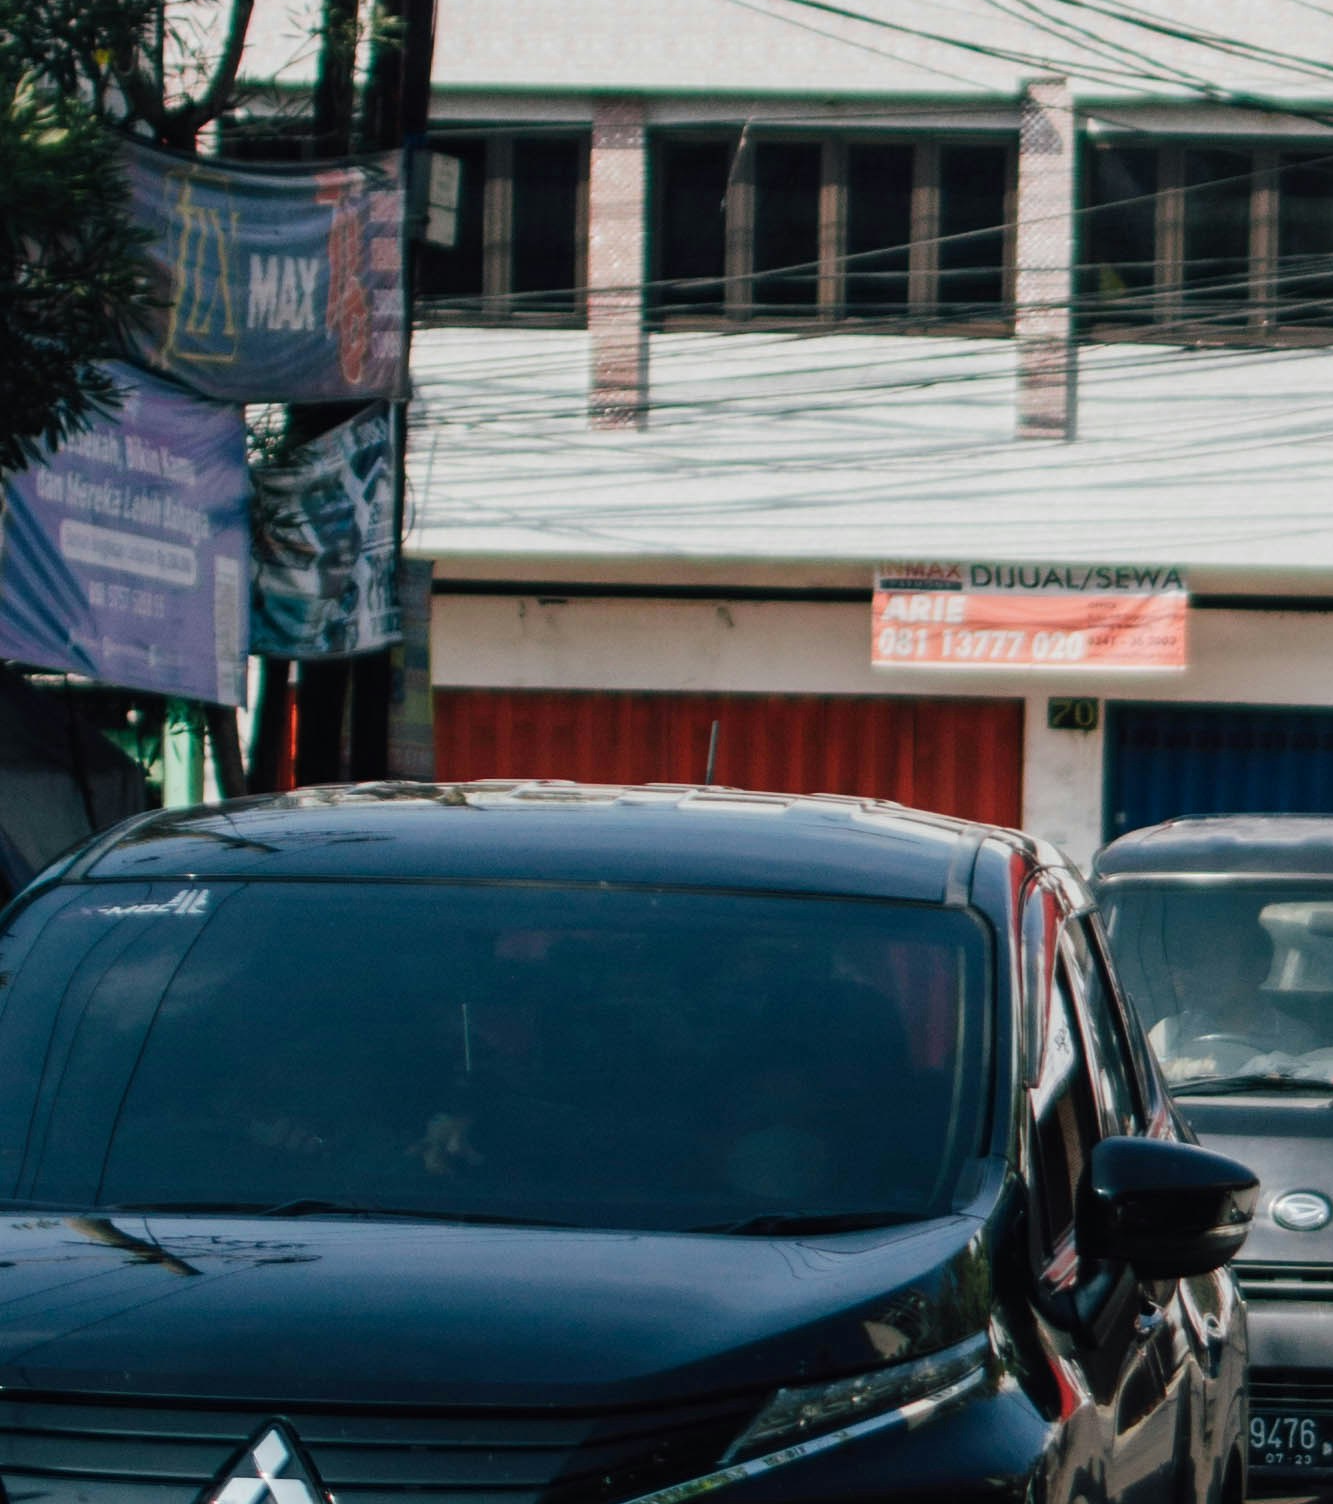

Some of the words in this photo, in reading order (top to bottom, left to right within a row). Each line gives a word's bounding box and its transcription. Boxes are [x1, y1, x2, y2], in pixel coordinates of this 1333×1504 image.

[246, 253, 320, 332] MAX
[970, 564, 1183, 590] DIJUAL/SEWA
[880, 594, 967, 623] ARIE
[878, 626, 928, 657] 081
[941, 628, 1025, 659] 13777
[1032, 631, 1086, 661] 020
[1250, 1416, 1316, 1449] 9476
